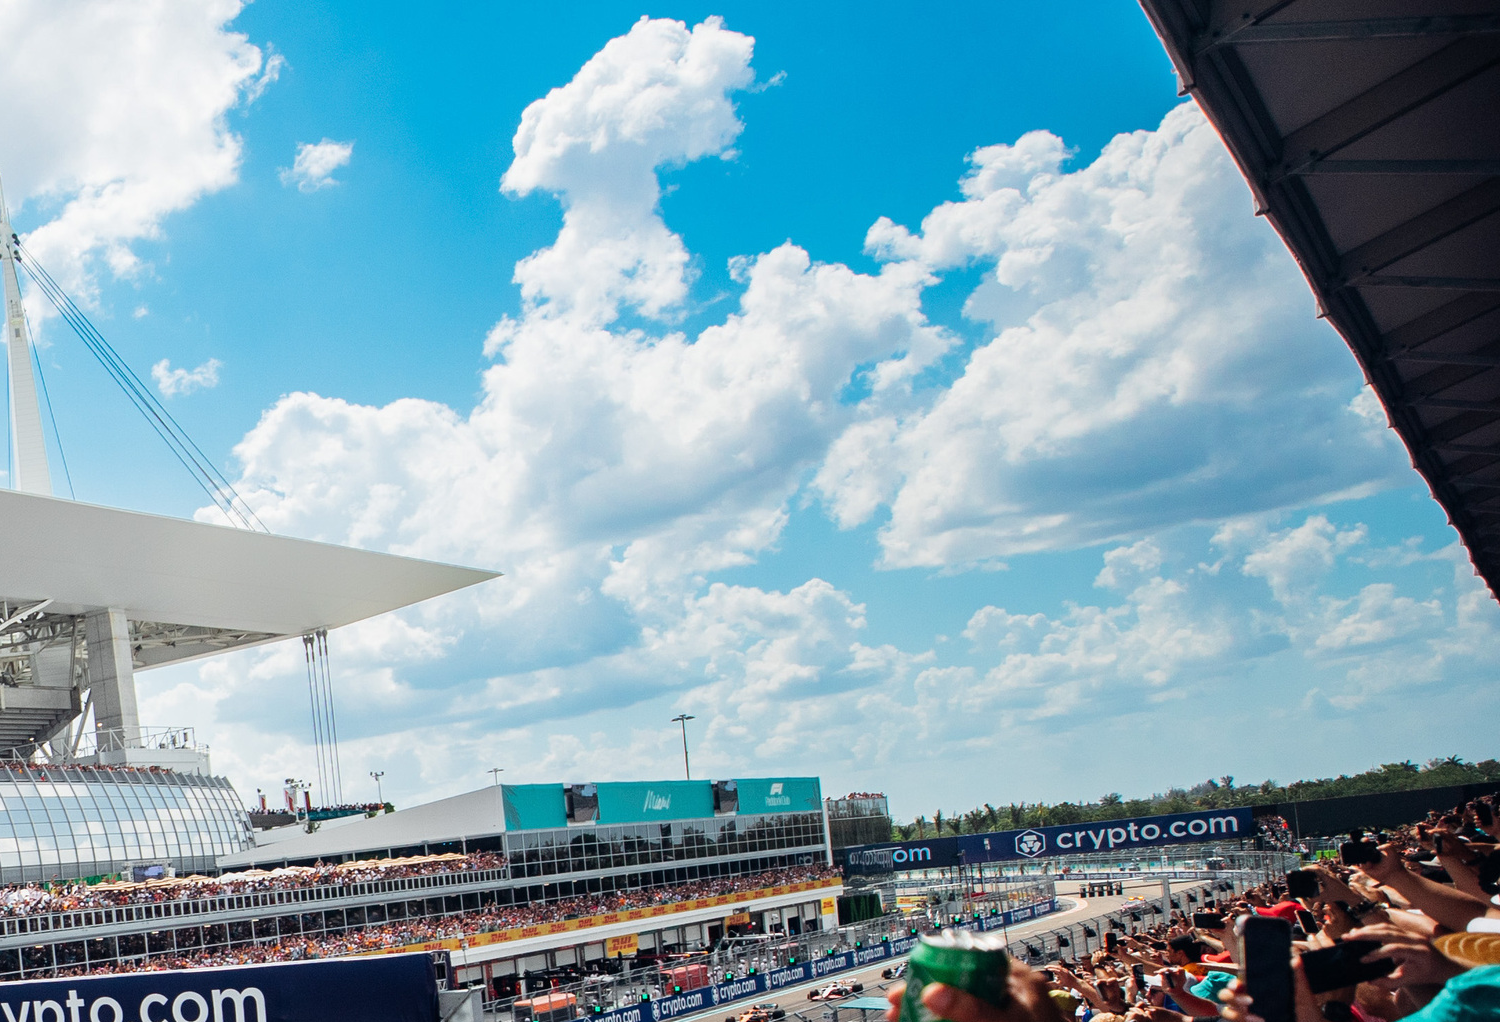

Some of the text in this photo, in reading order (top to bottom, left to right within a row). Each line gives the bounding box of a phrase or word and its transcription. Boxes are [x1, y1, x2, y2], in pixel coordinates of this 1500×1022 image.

[1056, 815, 1239, 848] crypto.com
[771, 966, 804, 986] crypto.com
[818, 955, 847, 974] crypto.com
[720, 978, 756, 1001] crypto.com
[661, 992, 703, 1015] crypto.com
